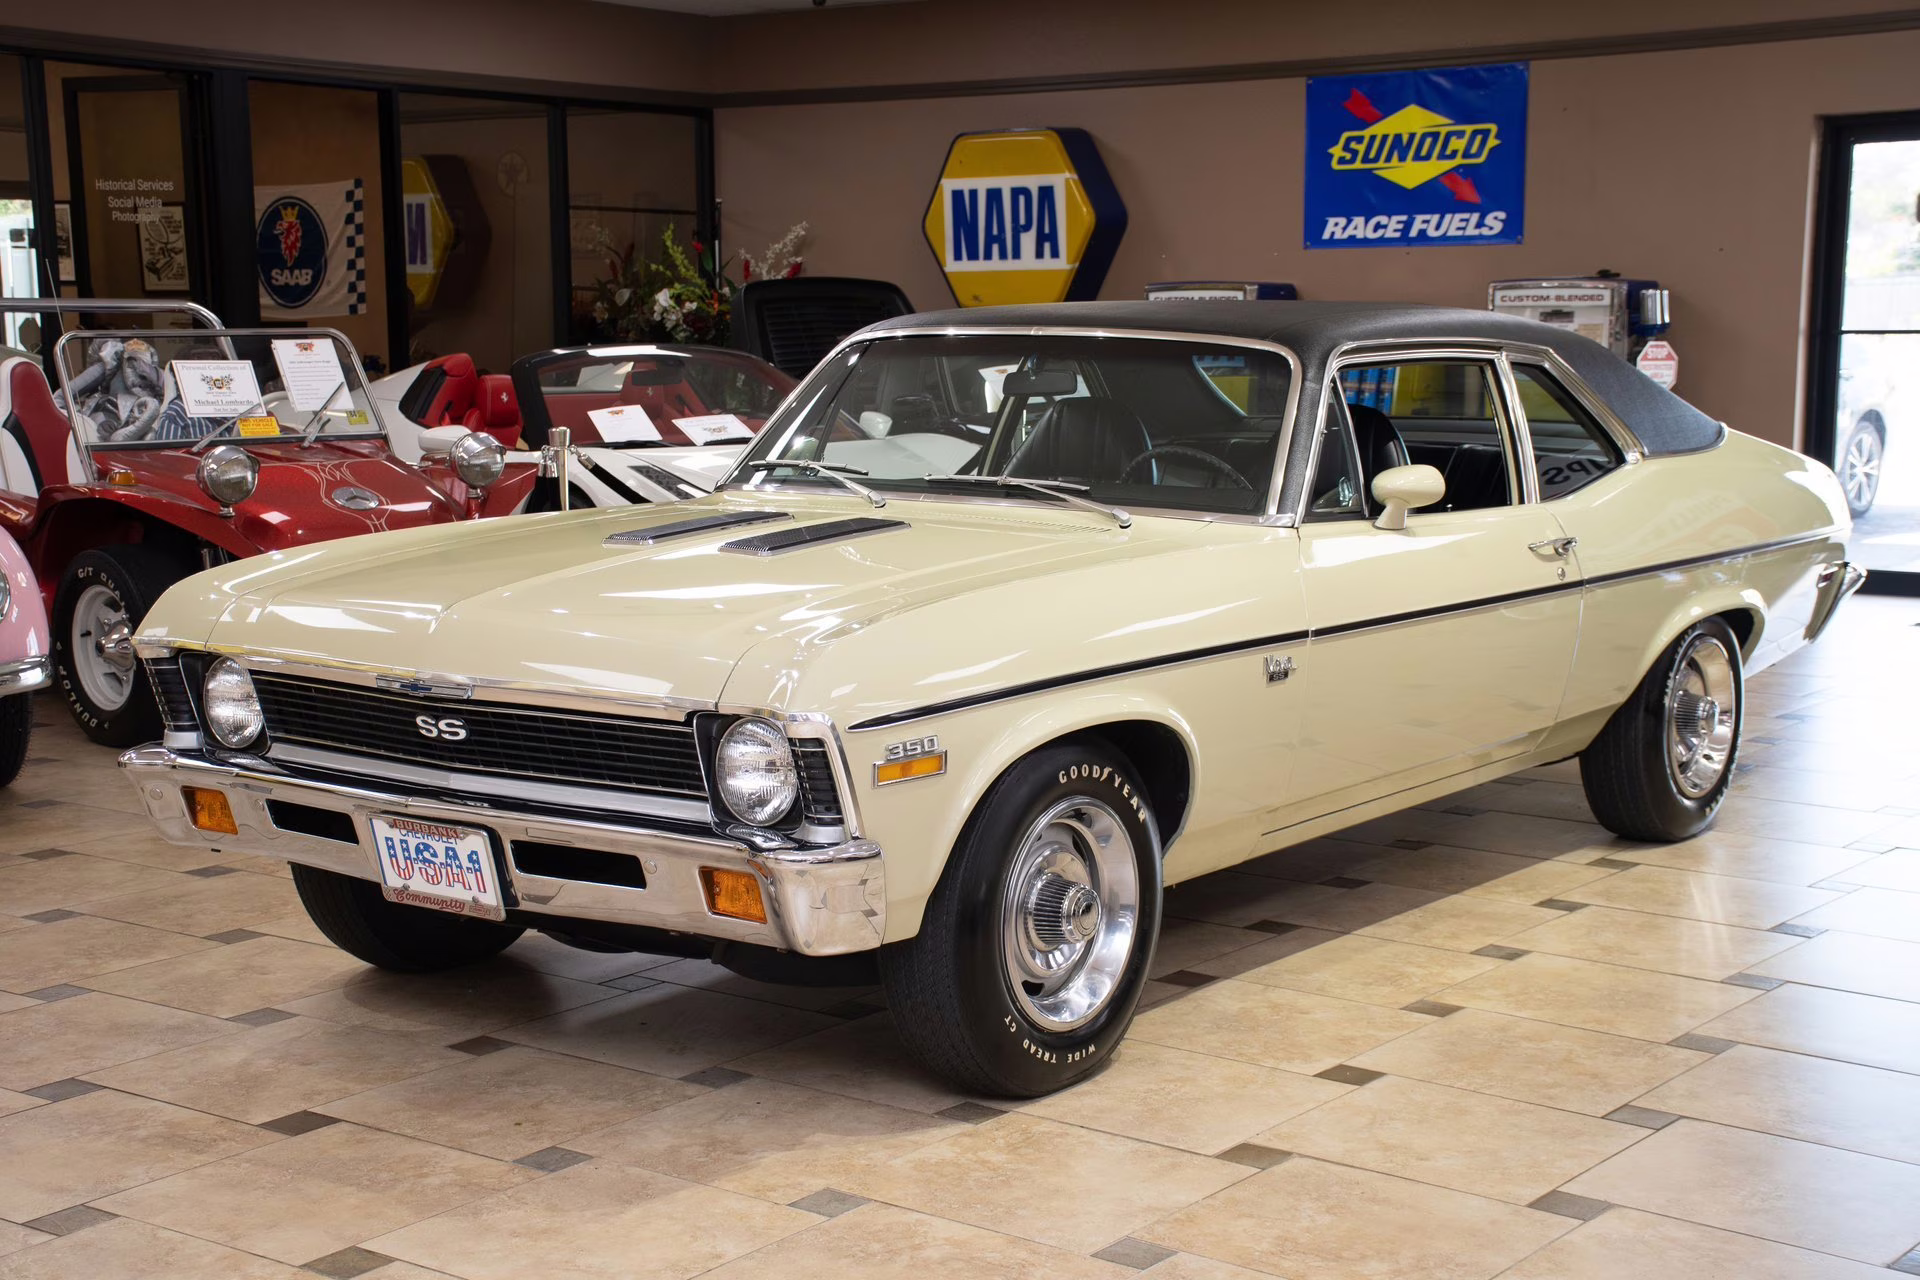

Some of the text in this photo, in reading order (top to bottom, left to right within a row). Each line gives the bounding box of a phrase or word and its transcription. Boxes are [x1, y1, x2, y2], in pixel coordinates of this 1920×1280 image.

[1336, 128, 1492, 165] SUNOCO
[95, 179, 175, 191] Historical Services
[108, 196, 162, 208] Social Media
[112, 210, 161, 224] Photography
[951, 185, 1060, 261] NAPA
[1321, 211, 1507, 240] RACE FUELS
[271, 268, 313, 286] SAAB
[59, 665, 98, 728] DUNLOP
[415, 715, 467, 740] SS
[885, 735, 940, 760] 350
[1058, 764, 1147, 824] GOODYEAR
[396, 820, 459, 838] BURBANK
[393, 888, 466, 913] Community
[1004, 1015, 1097, 1064] WIDE TREAD GT
